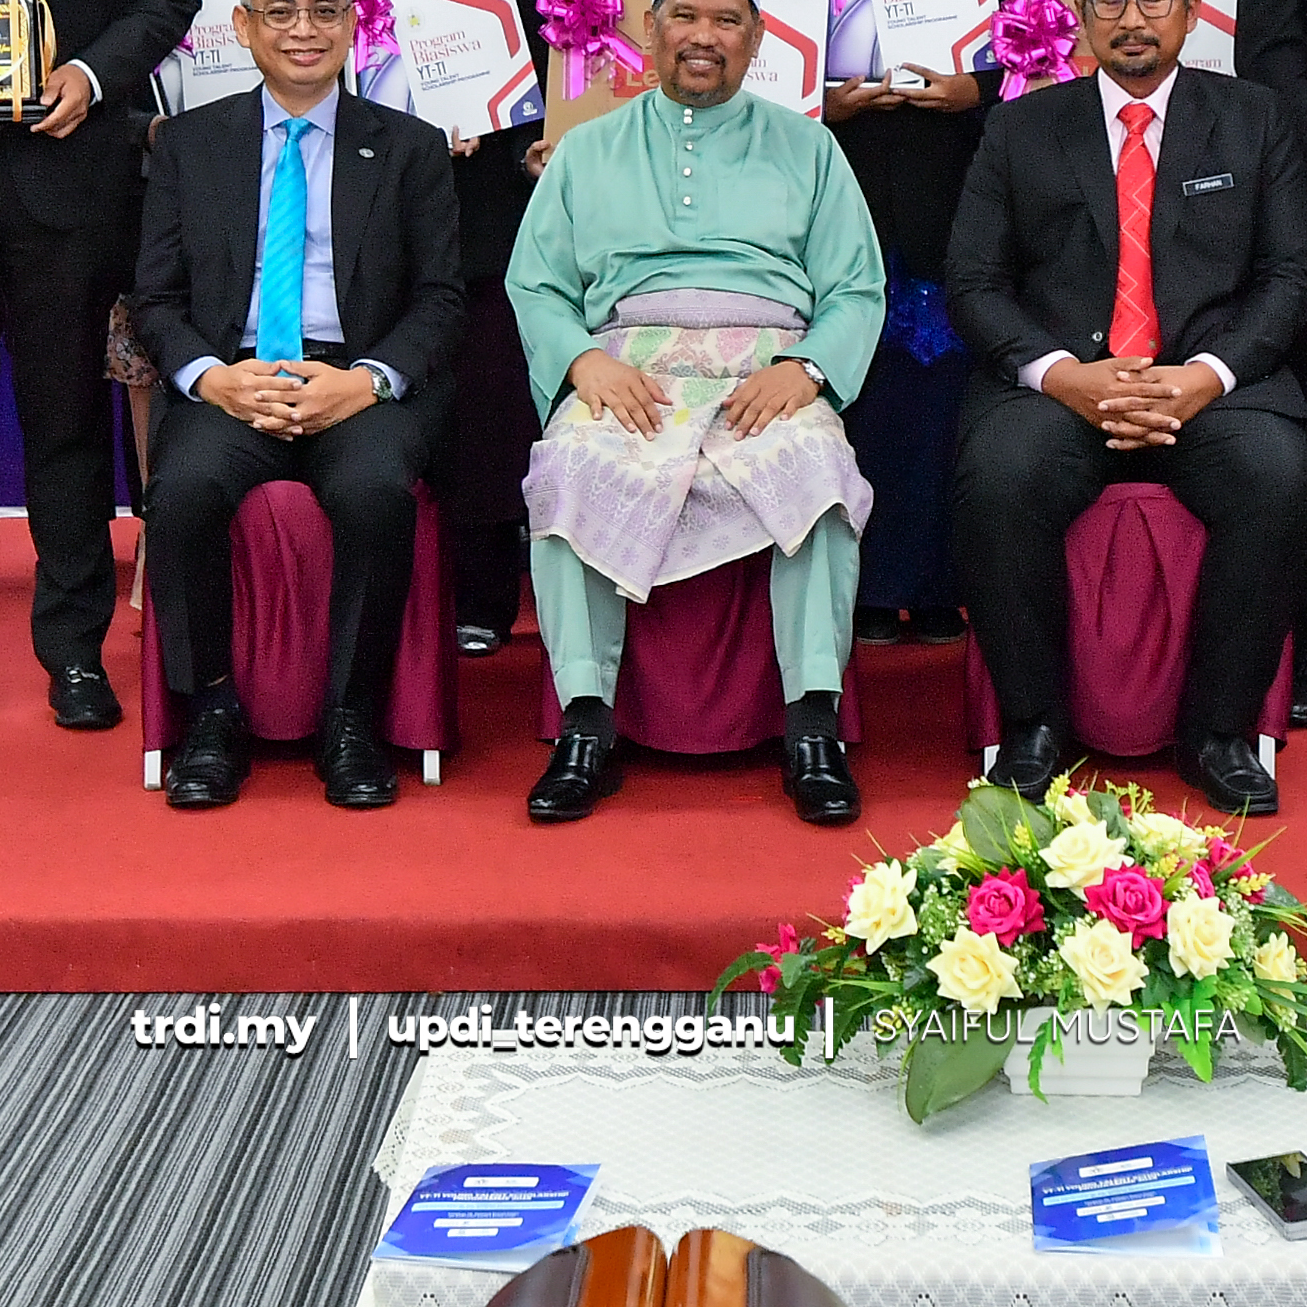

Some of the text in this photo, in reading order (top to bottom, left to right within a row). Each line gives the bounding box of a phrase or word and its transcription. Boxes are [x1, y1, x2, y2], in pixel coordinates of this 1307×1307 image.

[884, 1, 914, 19] YT-TI
[191, 34, 234, 49] Biasis
[410, 31, 465, 51] Program
[413, 40, 481, 65] Biasiswa
[416, 61, 447, 80] YT-TI
